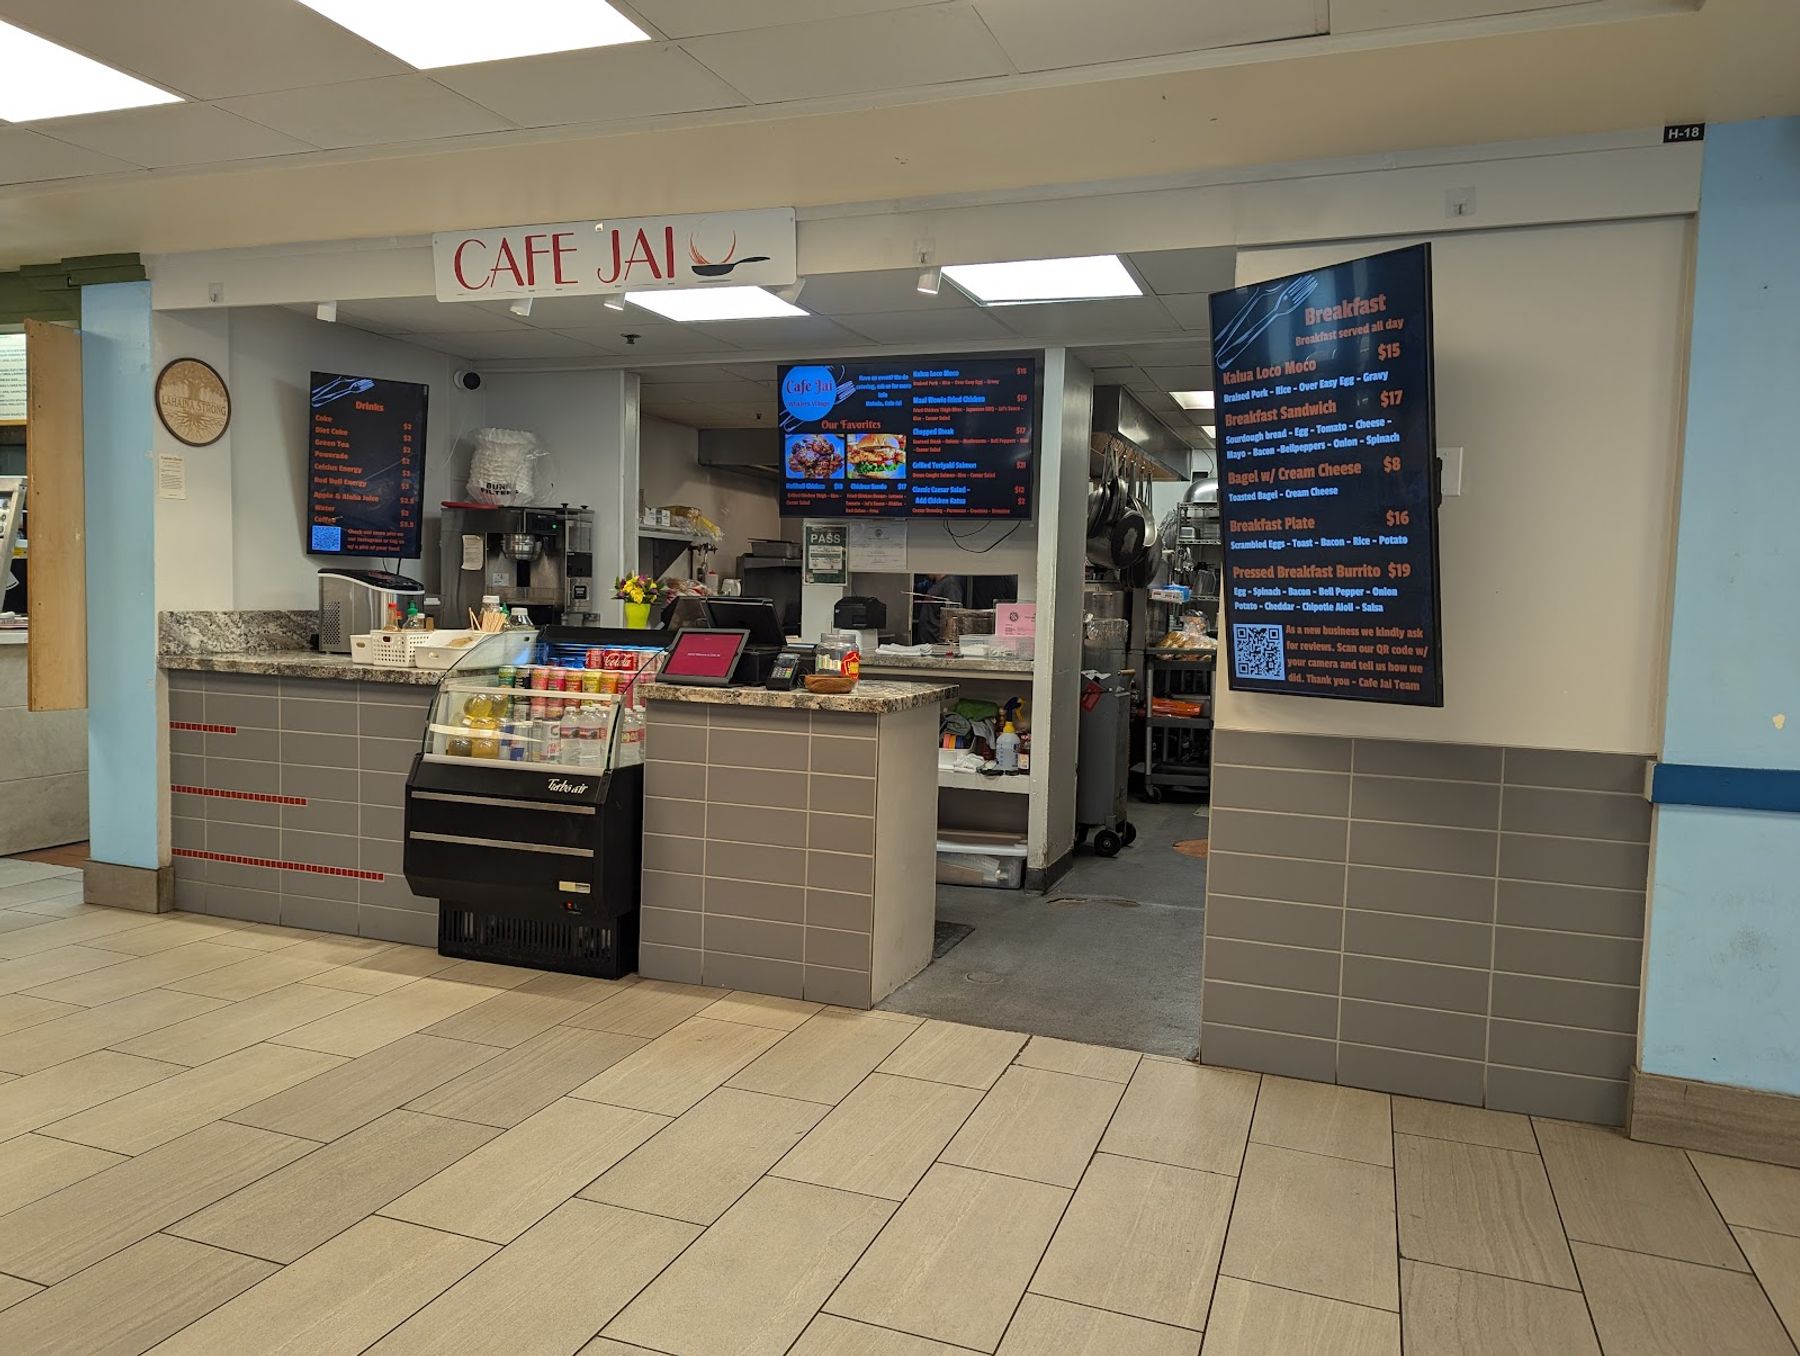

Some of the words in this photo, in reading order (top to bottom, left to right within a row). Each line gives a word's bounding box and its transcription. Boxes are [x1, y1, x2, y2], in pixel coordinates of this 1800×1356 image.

[1668, 127, 1699, 139] H-18
[454, 232, 579, 290] CAFE
[597, 226, 675, 283] JAI
[1305, 295, 1387, 326] Breakfast
[1295, 330, 1337, 346] Breakfast
[1339, 322, 1369, 338] served
[1372, 322, 1383, 332] all
[1386, 318, 1404, 330] day
[1378, 342, 1400, 361] $15
[1257, 364, 1281, 379] Loco
[1285, 359, 1316, 374] Moco
[786, 380, 811, 393] Cafe
[1224, 389, 1250, 402] Braised
[1251, 388, 1268, 400] Pork
[1275, 386, 1291, 395] Rice
[1299, 381, 1318, 391] Over
[1319, 377, 1337, 390] Easy
[1339, 376, 1354, 386] Egg
[1363, 370, 1388, 382] Gravy
[355, 401, 384, 412] Drinks
[1380, 389, 1403, 408] $17
[1225, 410, 1278, 427] Breakfast
[1281, 400, 1337, 420] Sandwich
[821, 421, 838, 429] Our
[841, 420, 881, 429] Favorites
[1226, 432, 1264, 444] Sourdough
[1265, 429, 1287, 440] bread
[1294, 427, 1309, 437] Egg
[1316, 422, 1347, 434] Tomato
[1355, 418, 1385, 429] Cheese
[1227, 449, 1246, 460] Mayo
[1253, 446, 1275, 456] Bacon
[1333, 438, 1358, 448] Onion
[1366, 432, 1400, 445] Spinach
[339, 465, 363, 474] Energy
[1228, 470, 1258, 486] Bagel
[1261, 469, 1276, 484] w/
[1279, 466, 1315, 481] Cream
[1318, 462, 1362, 477] Cheese
[1383, 455, 1400, 473] $8
[344, 479, 367, 488] Energy
[1229, 493, 1256, 502] Toasted
[1258, 490, 1278, 501] Bagel
[1285, 488, 1308, 498] Cream
[1311, 486, 1338, 496] Cheese
[1230, 518, 1282, 532] Breakfast
[1285, 516, 1315, 529] Plate
[1386, 509, 1410, 527] $16
[811, 533, 840, 543] PASS
[1230, 541, 1267, 550] Scrambled
[1268, 540, 1285, 550] Eggs
[1292, 539, 1313, 548] Toast
[1320, 538, 1344, 547] Bacon
[1353, 537, 1370, 546] Rice
[1379, 536, 1408, 544] Potato
[1232, 566, 1274, 578] Pressed
[1277, 565, 1333, 578] Breakfast
[1336, 564, 1381, 578] Burrito
[1388, 561, 1411, 579] $19
[1234, 588, 1246, 596] Egg
[1252, 588, 1281, 596] Spinach
[1288, 588, 1311, 596] Bacon
[1318, 588, 1333, 596] Bell
[1335, 588, 1364, 597] Pepper
[1372, 587, 1397, 596] Onion
[1235, 602, 1257, 610] Potato
[1265, 603, 1294, 611] Cheddar
[1302, 603, 1334, 612] Chipotle
[1335, 603, 1353, 612] Aioli
[1362, 603, 1383, 612] Salsa
[1286, 625, 1295, 634] As
[1323, 625, 1359, 636] business
[1361, 628, 1374, 636] we
[1376, 626, 1404, 639] kindly
[1407, 628, 1424, 638] ask
[1286, 641, 1299, 650] for
[1337, 642, 1357, 653] Scan
[1359, 644, 1374, 653] our
[1377, 644, 1389, 655] QR
[1391, 645, 1413, 655] code
[1416, 646, 1428, 658] w/
[1288, 659, 1306, 667] your
[1308, 660, 1338, 668] camera
[1340, 660, 1357, 669] and
[1359, 660, 1373, 671] tell
[1376, 663, 1386, 671] us
[1388, 662, 1408, 672] how
[1409, 665, 1423, 673] we
[1306, 674, 1332, 685] Thank
[1333, 677, 1349, 686] you
[1358, 678, 1377, 687] Cafe
[1380, 679, 1392, 689] Jai
[1394, 680, 1420, 690] Team
